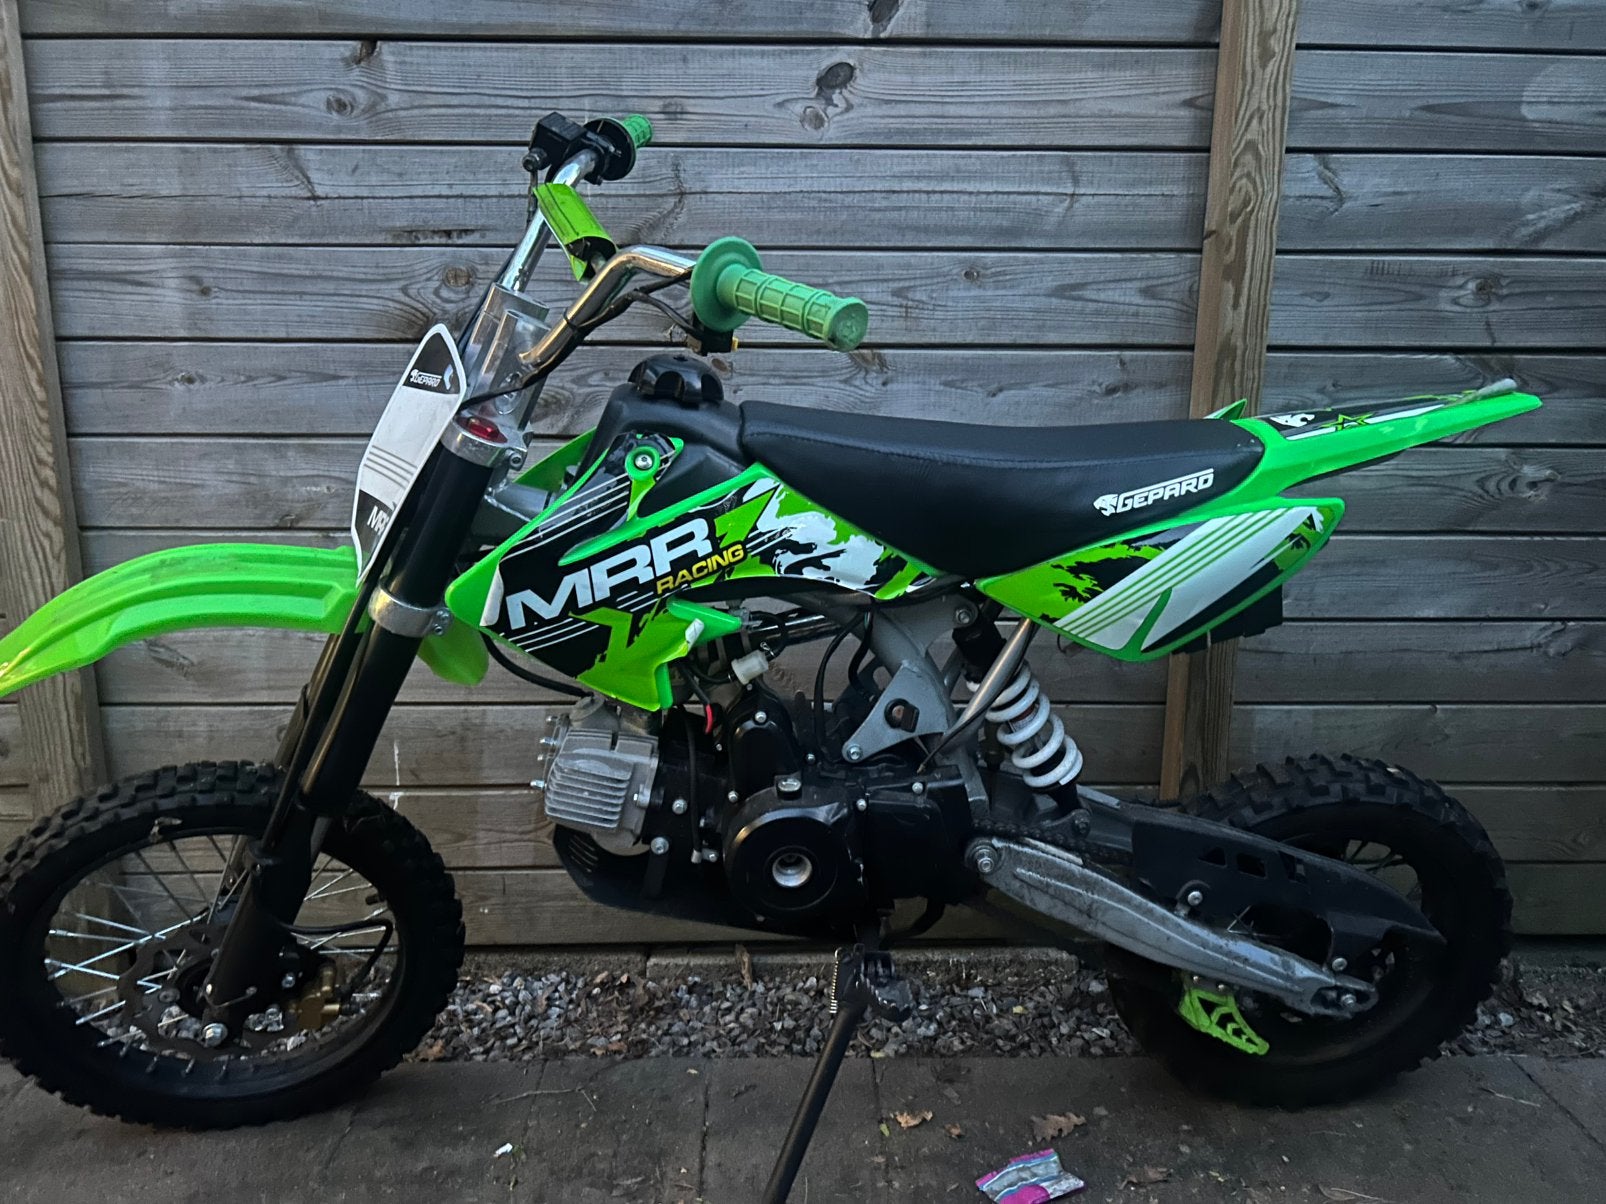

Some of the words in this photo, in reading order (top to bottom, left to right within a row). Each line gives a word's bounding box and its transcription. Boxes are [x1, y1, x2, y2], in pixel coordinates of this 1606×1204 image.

[1116, 468, 1214, 513] GEPARD
[506, 518, 713, 630] MRR
[656, 544, 745, 594] RACING
